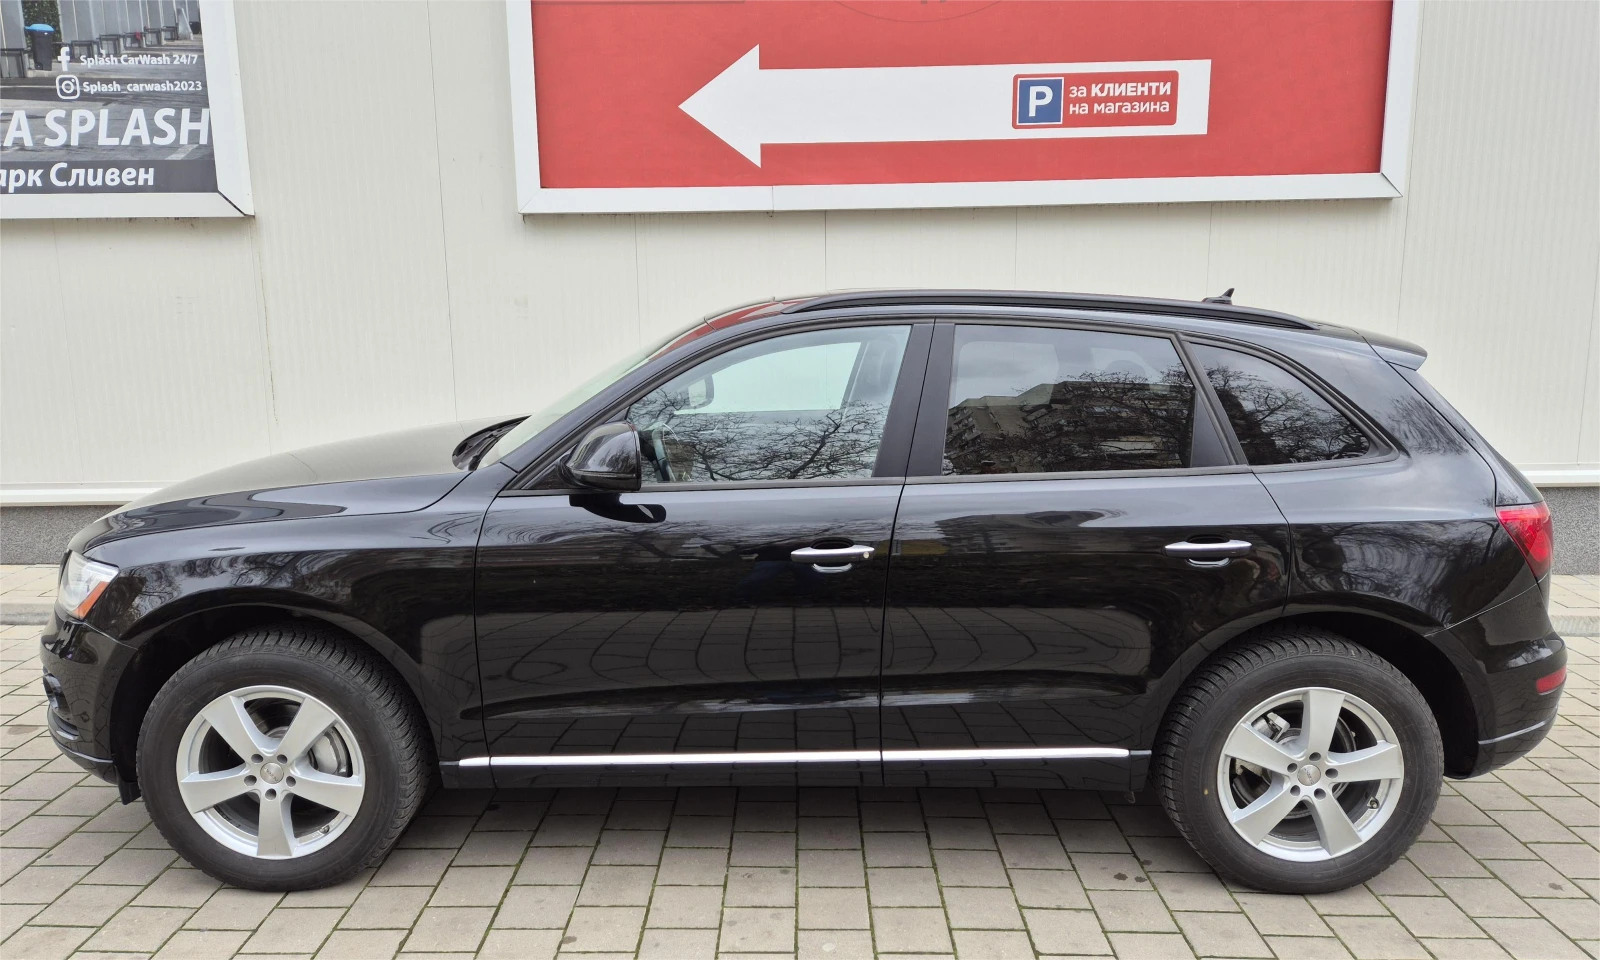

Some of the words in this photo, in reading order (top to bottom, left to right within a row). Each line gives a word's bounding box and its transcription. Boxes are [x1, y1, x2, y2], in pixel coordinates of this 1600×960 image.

[79, 54, 119, 68] Splash
[120, 54, 171, 65] CarWash
[172, 54, 198, 65] 24/7
[1069, 86, 1087, 98] за
[1091, 82, 1172, 97] КЛИЕНТИ
[1028, 86, 1053, 117] P
[1069, 103, 1089, 115] на
[1093, 101, 1170, 114] магазина
[44, 107, 210, 147] SPLASH
[50, 162, 155, 187] Сливен
